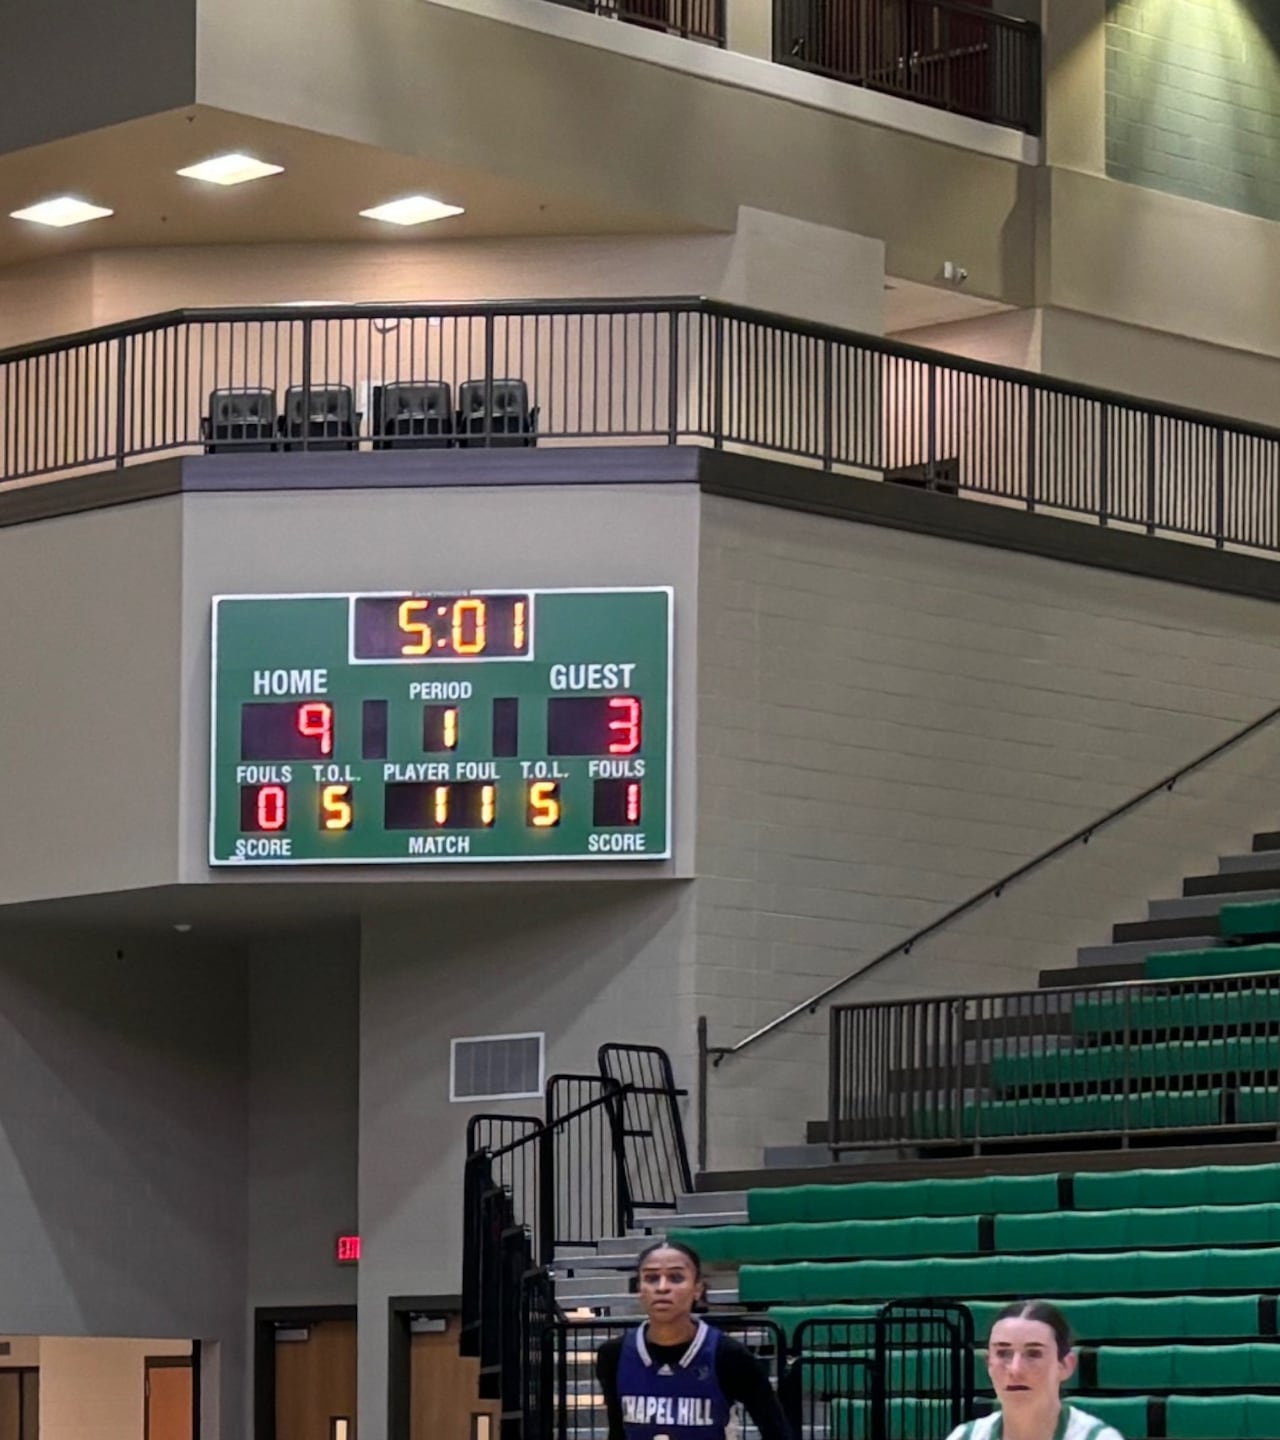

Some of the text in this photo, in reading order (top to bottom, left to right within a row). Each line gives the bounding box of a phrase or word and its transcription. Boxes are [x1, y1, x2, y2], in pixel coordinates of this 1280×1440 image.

[398, 599, 526, 654] 5:01
[253, 668, 328, 695] HOME
[409, 681, 472, 700] PERIOD
[549, 663, 636, 691] GUEST
[297, 703, 332, 754] 9
[443, 707, 457, 748] 1
[608, 698, 640, 753] 3
[236, 765, 292, 783] FOULS
[313, 765, 361, 782] T.O.L.
[383, 762, 501, 782] PLAYER FOUL
[520, 761, 569, 779] T.O.L.
[588, 760, 645, 778] FOULS
[256, 786, 286, 830] 0
[323, 786, 353, 829] 5
[530, 782, 561, 827] 5
[626, 784, 639, 821] 1
[235, 838, 292, 856] SCORE
[408, 836, 470, 854] MATCH
[588, 833, 645, 852] SCORE
[621, 1396, 713, 1426] CHAPEL HILL
